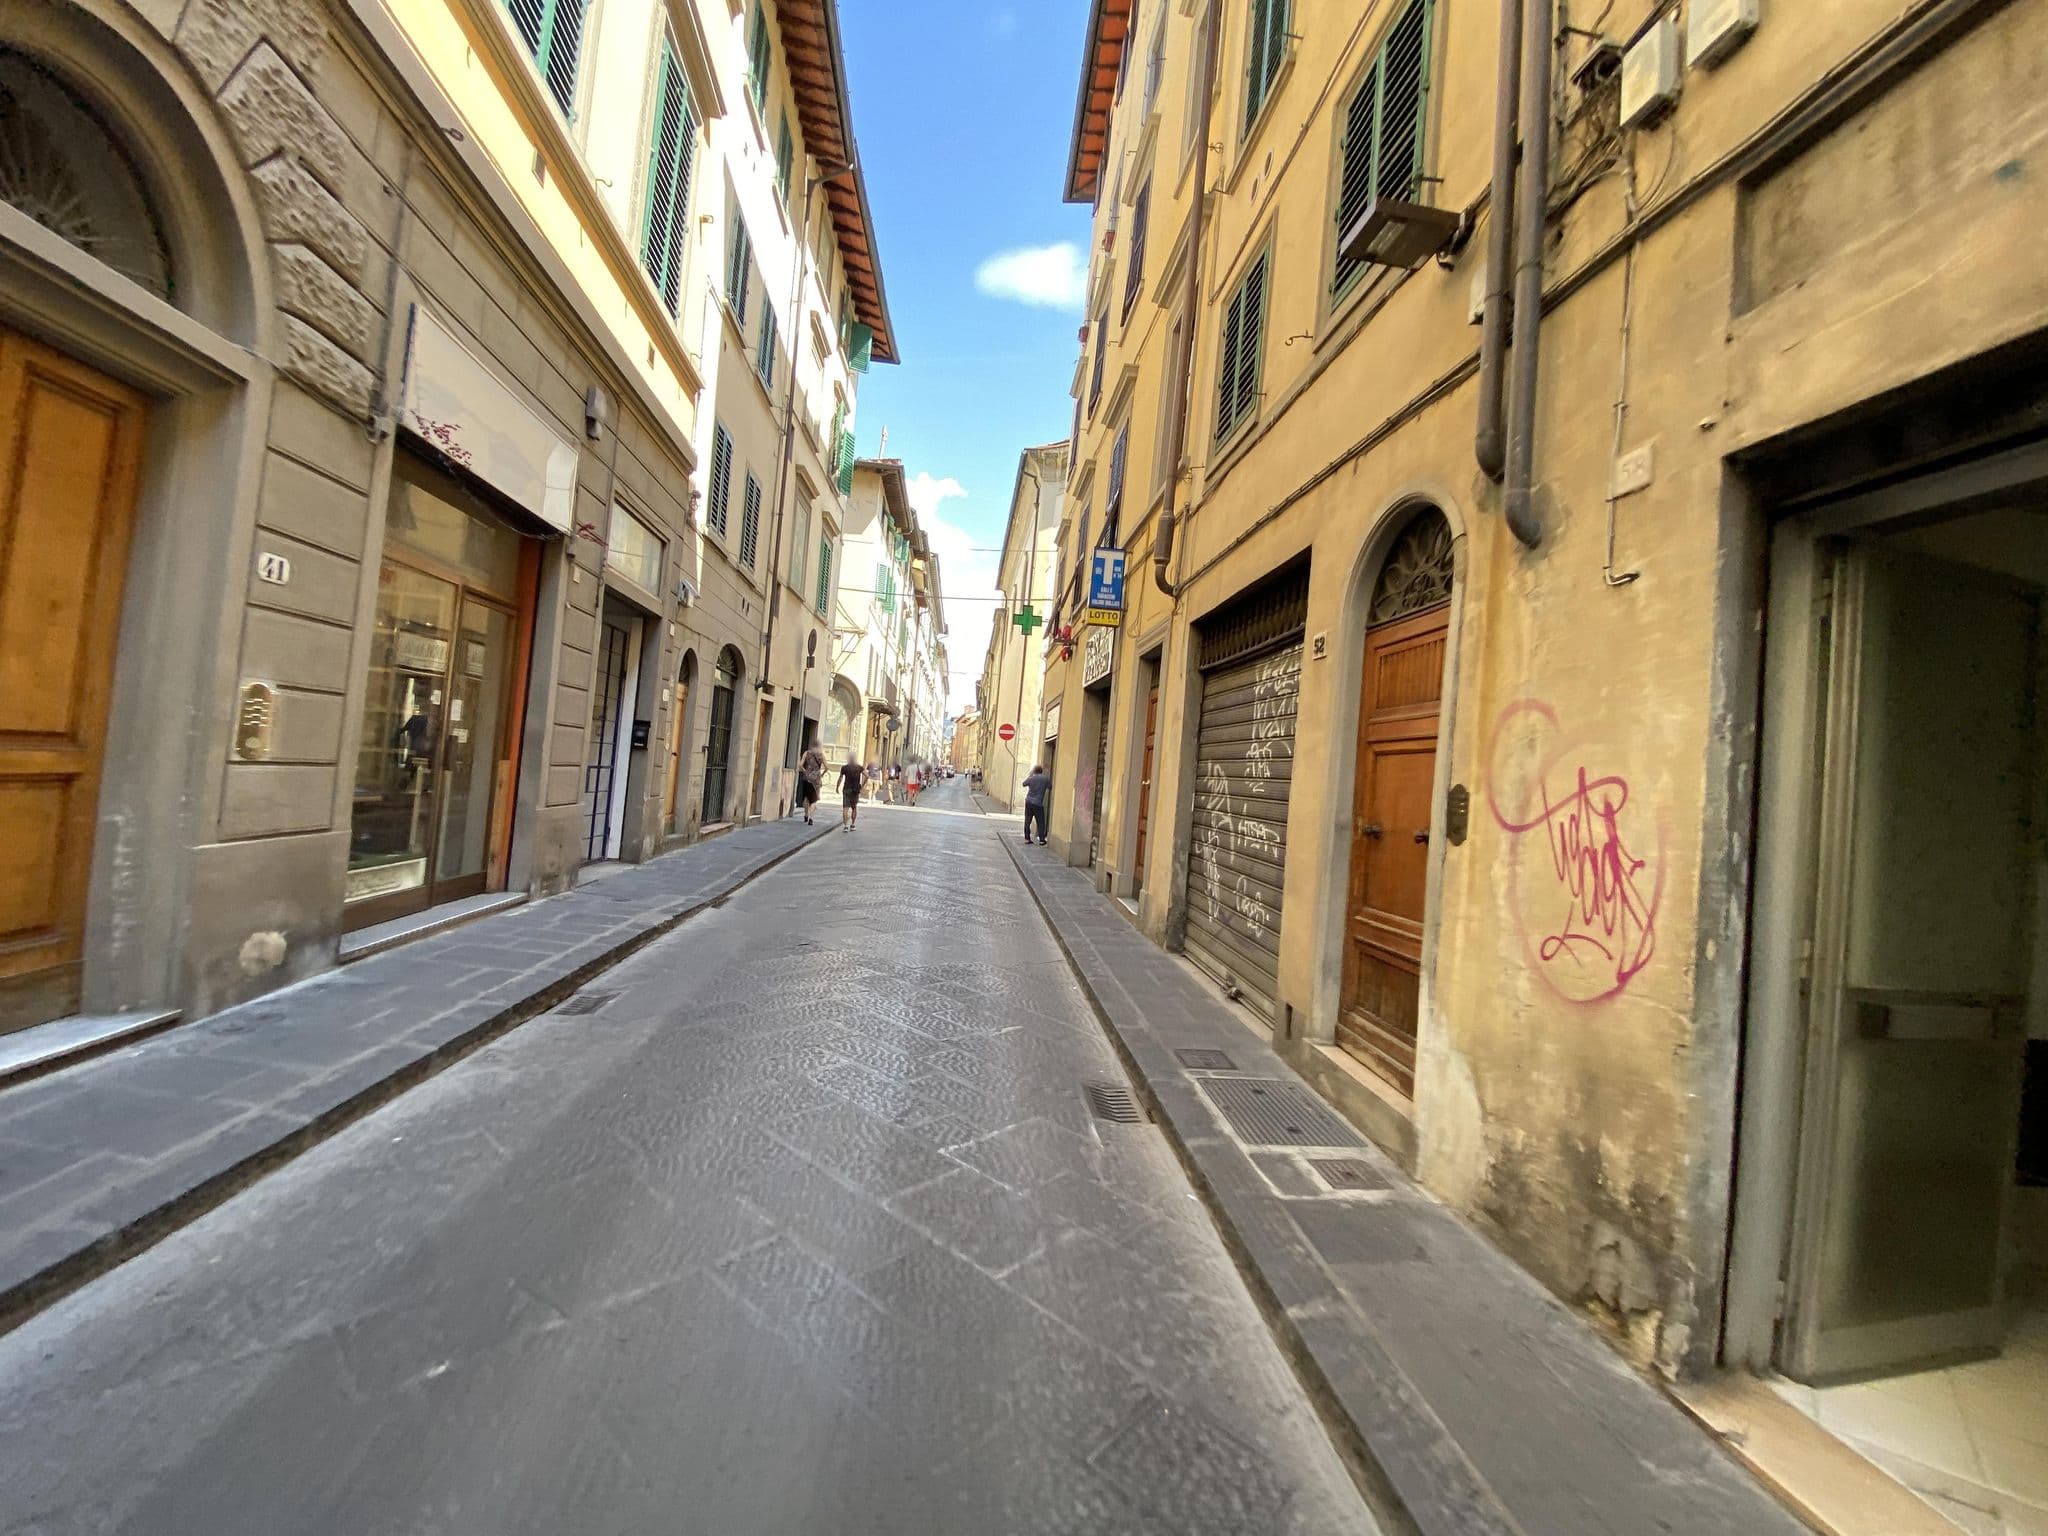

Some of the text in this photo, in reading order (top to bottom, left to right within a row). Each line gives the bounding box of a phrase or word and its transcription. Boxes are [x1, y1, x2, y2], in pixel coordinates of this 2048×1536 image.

[263, 557, 284, 580] 41
[1096, 549, 1124, 585] T
[1089, 610, 1119, 620] LOTTO
[1314, 636, 1325, 654] 52
